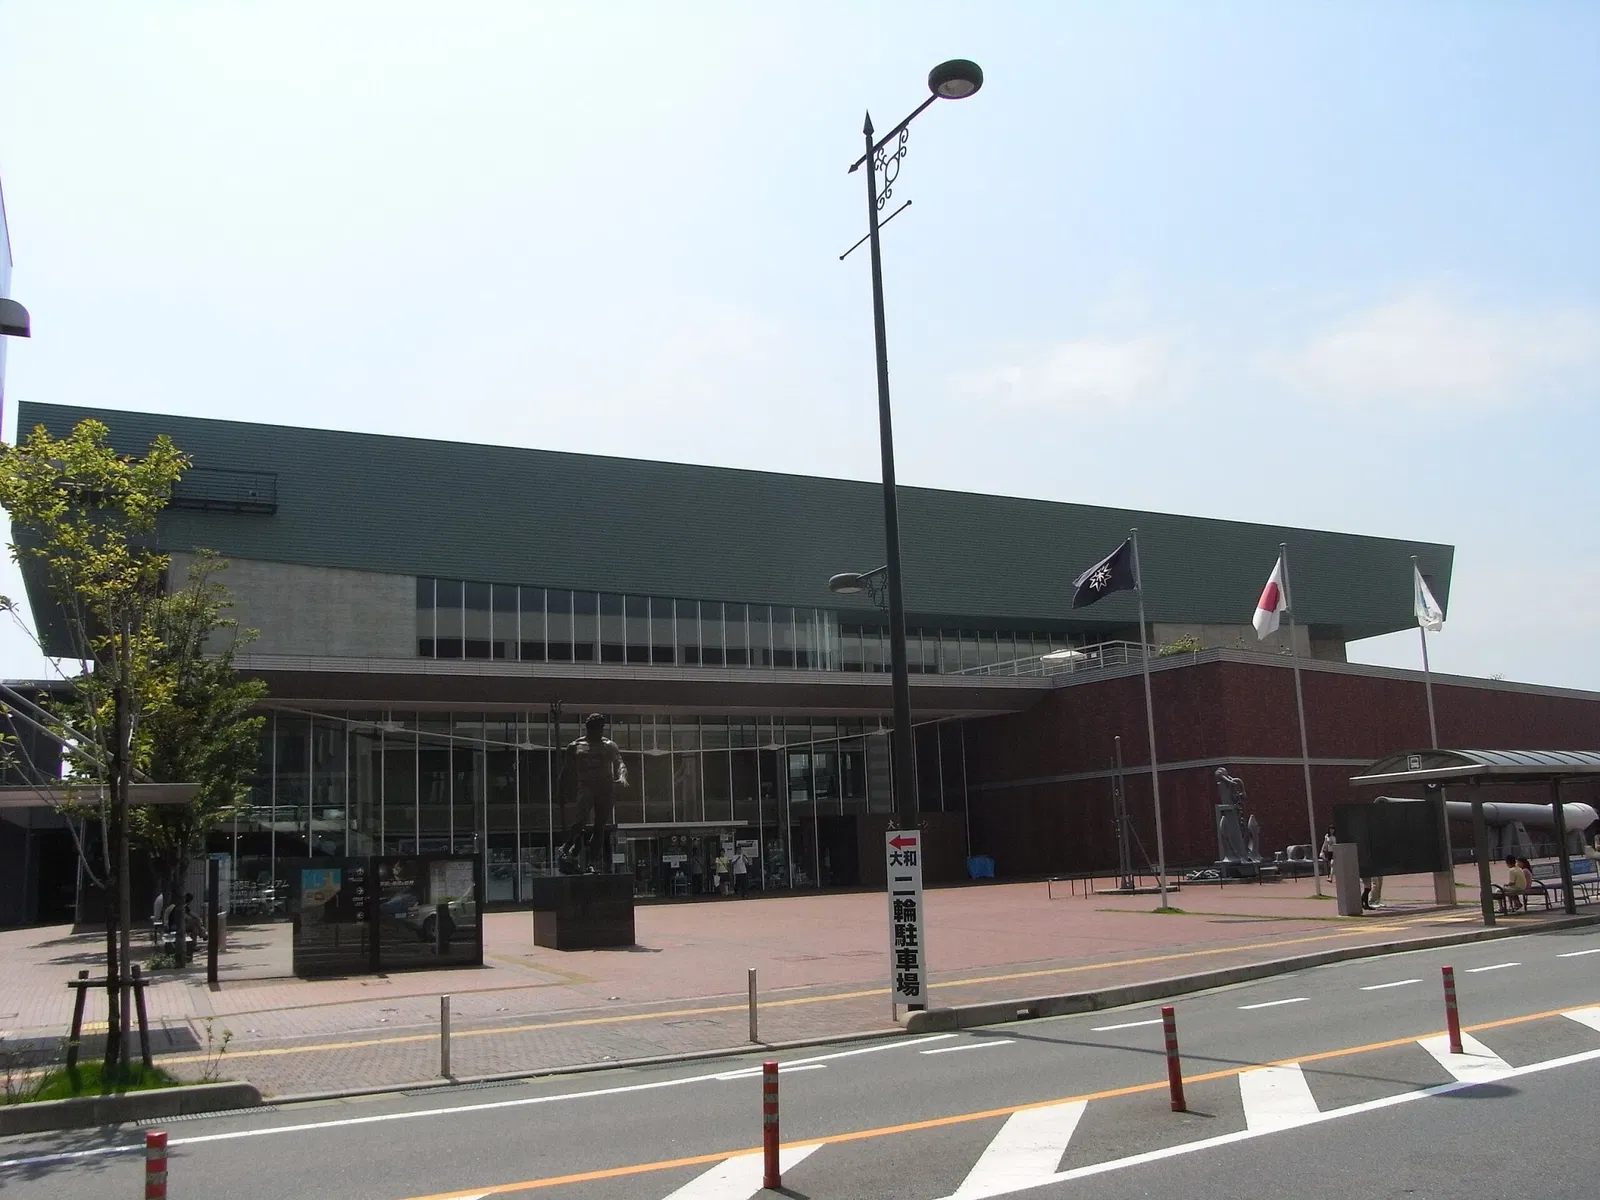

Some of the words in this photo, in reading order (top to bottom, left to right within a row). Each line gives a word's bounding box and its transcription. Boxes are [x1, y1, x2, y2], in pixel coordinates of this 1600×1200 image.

[890, 851, 917, 867] 大和
[892, 876, 920, 997] 二輪駐車場
